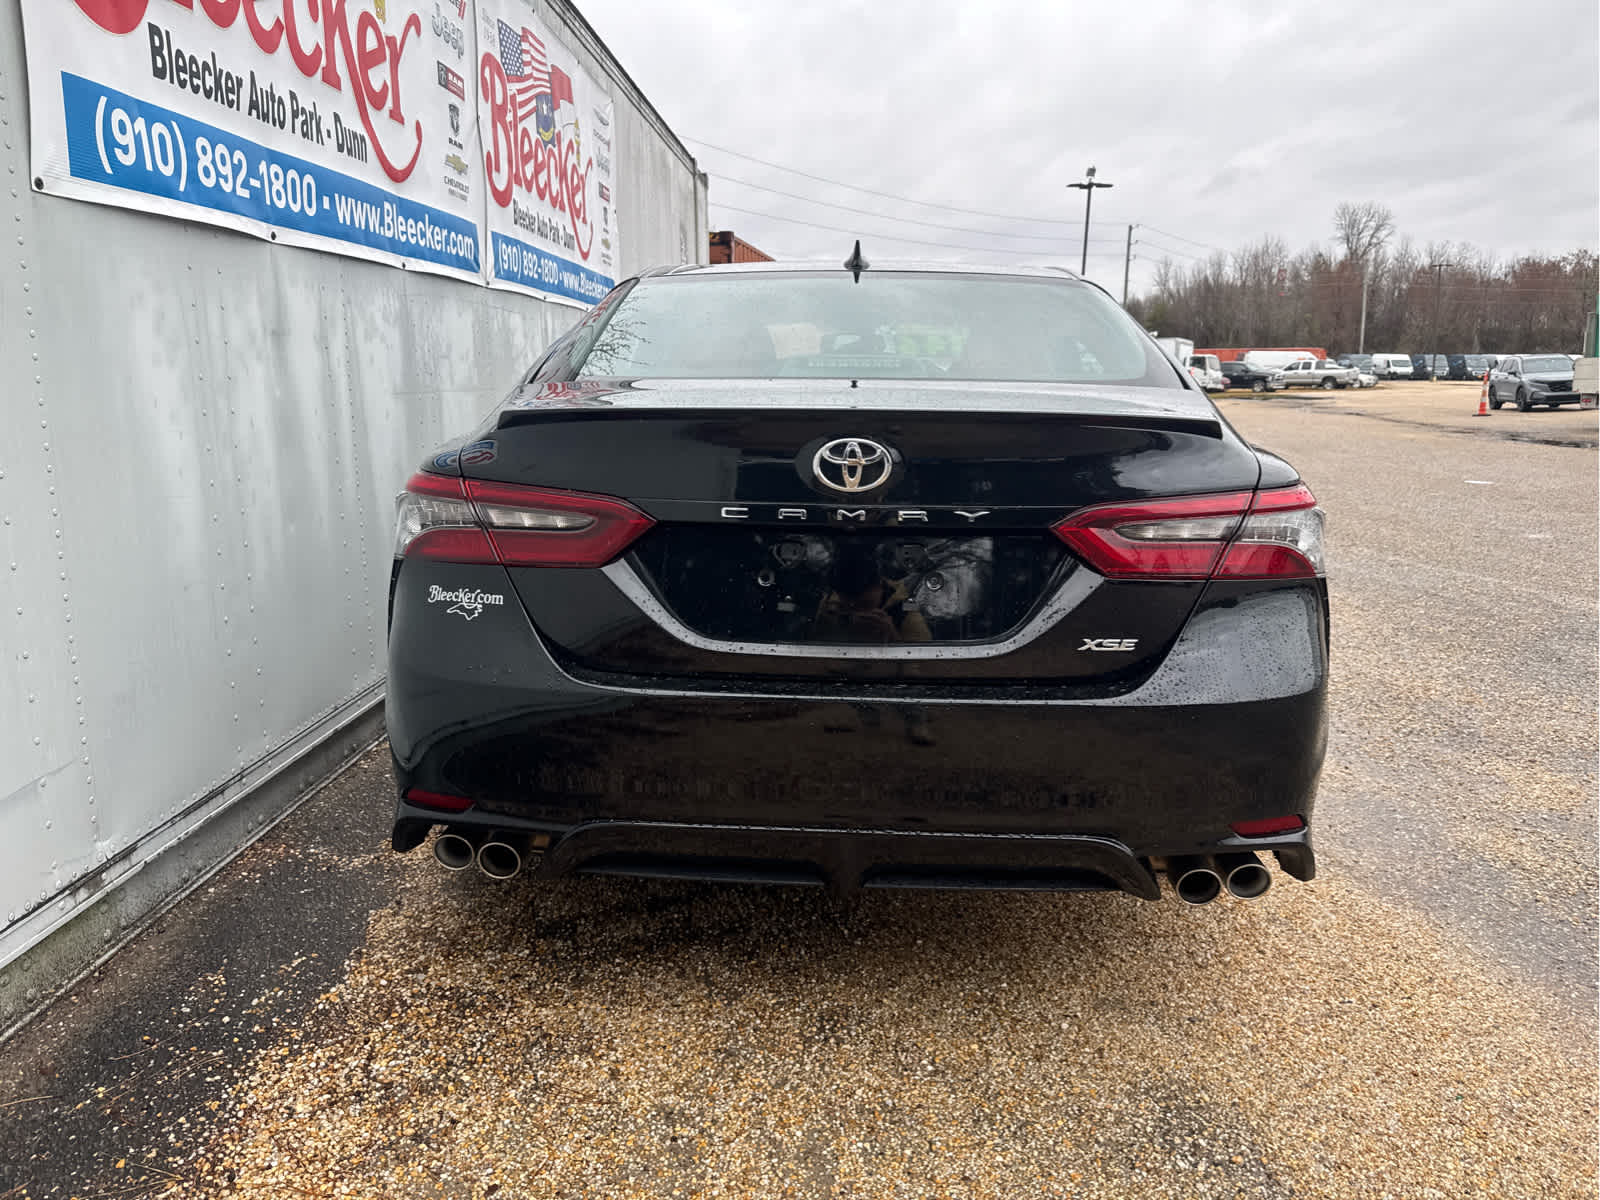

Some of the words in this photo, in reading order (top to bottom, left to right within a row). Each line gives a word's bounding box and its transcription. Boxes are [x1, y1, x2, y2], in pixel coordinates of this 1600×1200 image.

[147, 22, 243, 112] Bleecker
[248, 70, 287, 131] Auto
[289, 89, 325, 146] Park
[333, 111, 368, 164] Dunn
[448, 136, 464, 151] RAM
[480, 51, 593, 261] Bleecker
[95, 95, 188, 193] (910)
[195, 136, 317, 217] 892-1800
[334, 192, 475, 260] www.Bleecker.com
[498, 239, 521, 280] (910)
[522, 249, 559, 285] 892-1800
[721, 506, 991, 522] CAMRY
[1076, 638, 1139, 651] XSE
